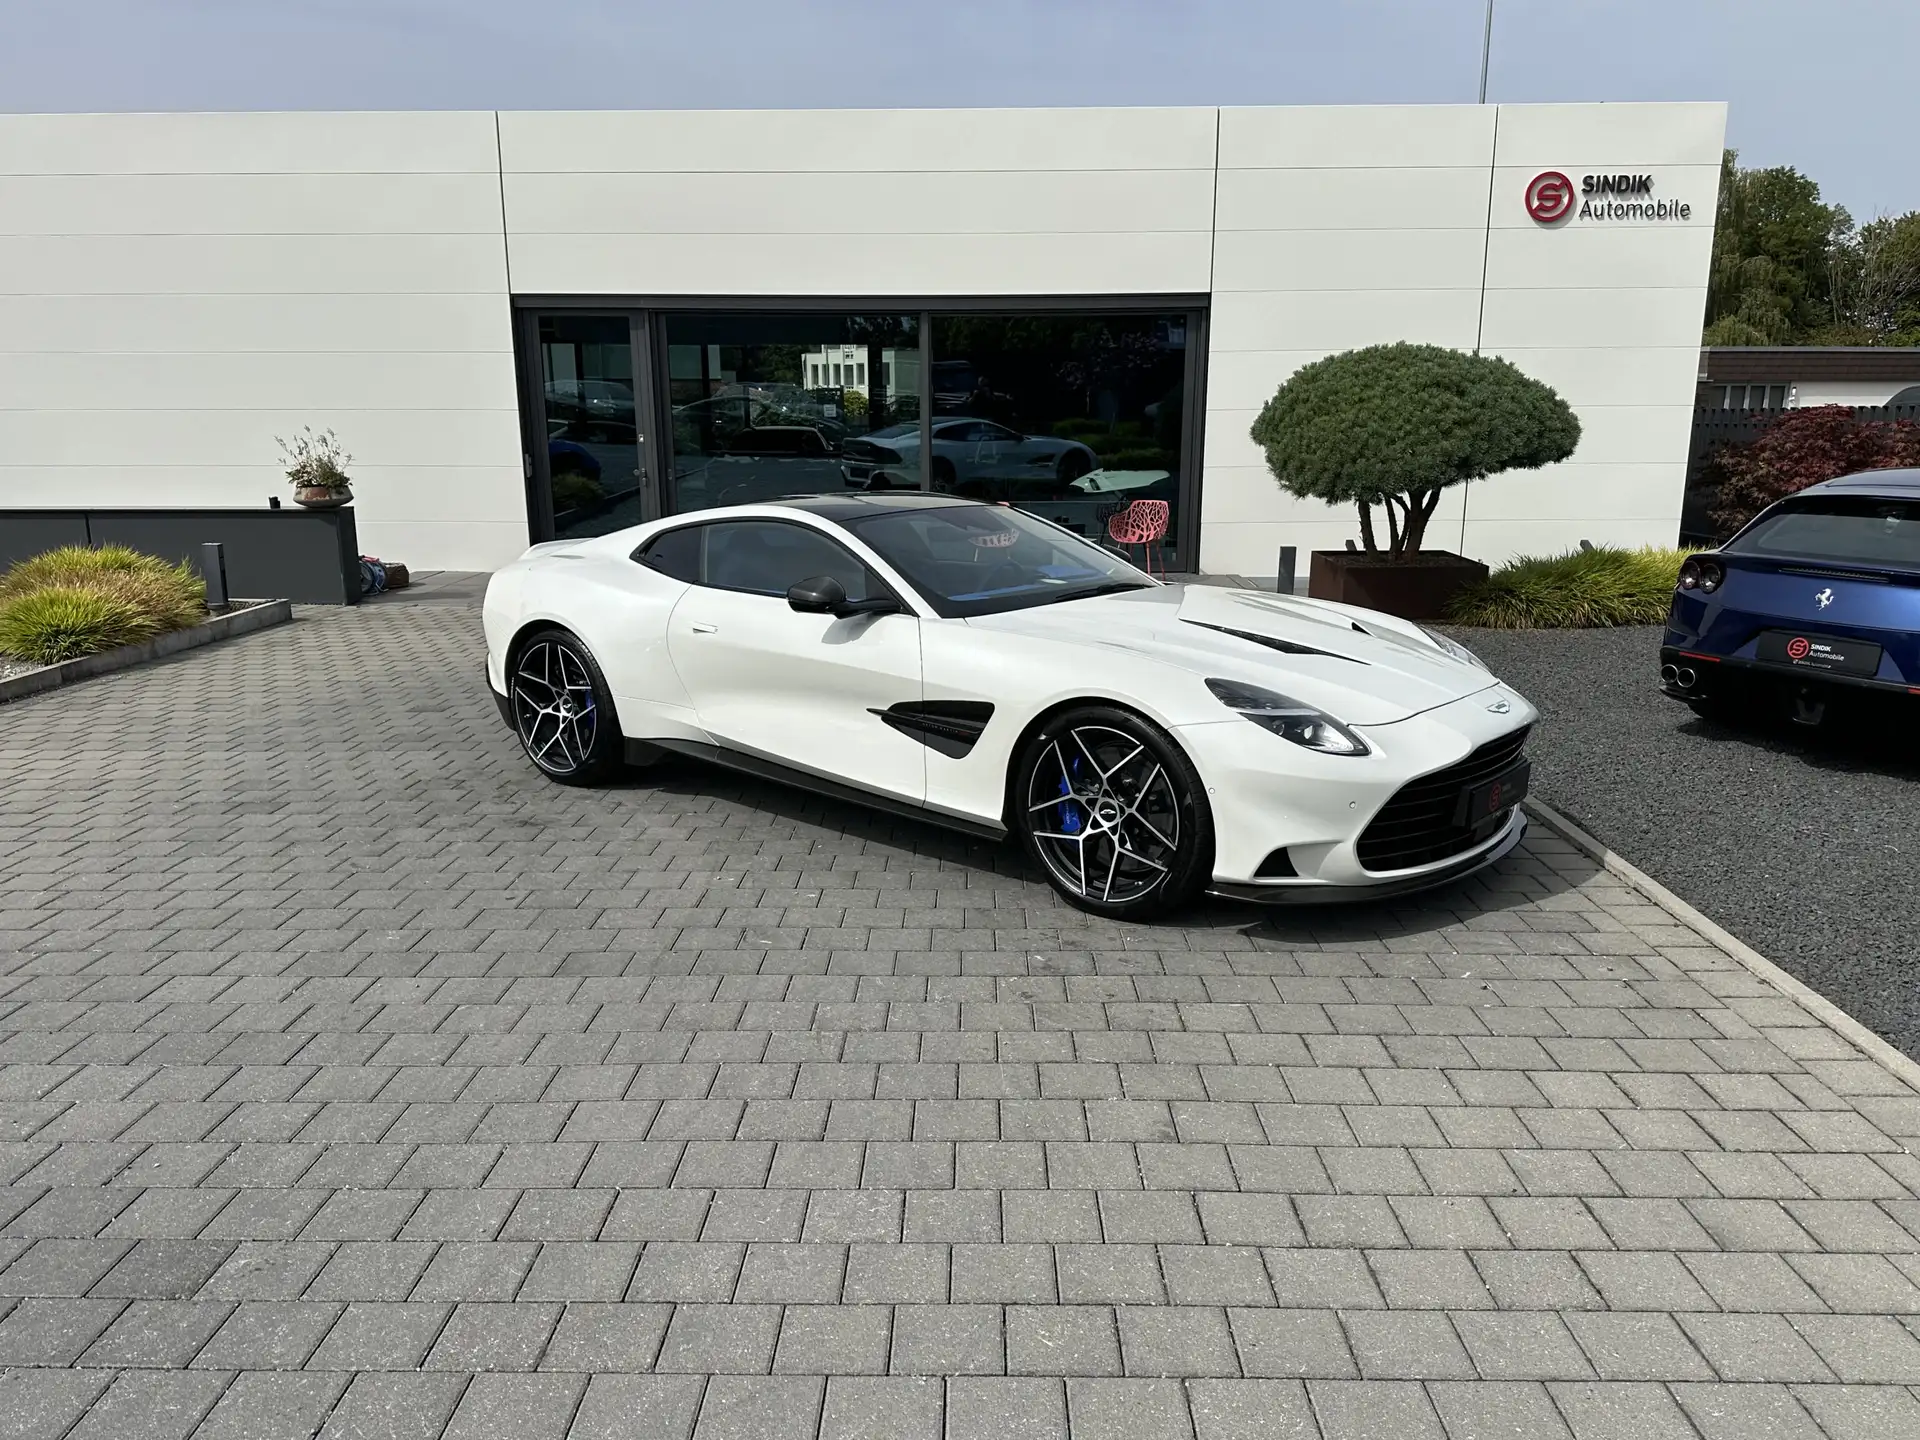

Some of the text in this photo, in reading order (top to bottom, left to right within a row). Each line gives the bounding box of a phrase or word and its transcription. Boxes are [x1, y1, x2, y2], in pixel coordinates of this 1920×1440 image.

[1581, 174, 1653, 194] SINDIK
[1579, 199, 1691, 218] Automobile
[1809, 651, 1845, 661] Automobile
